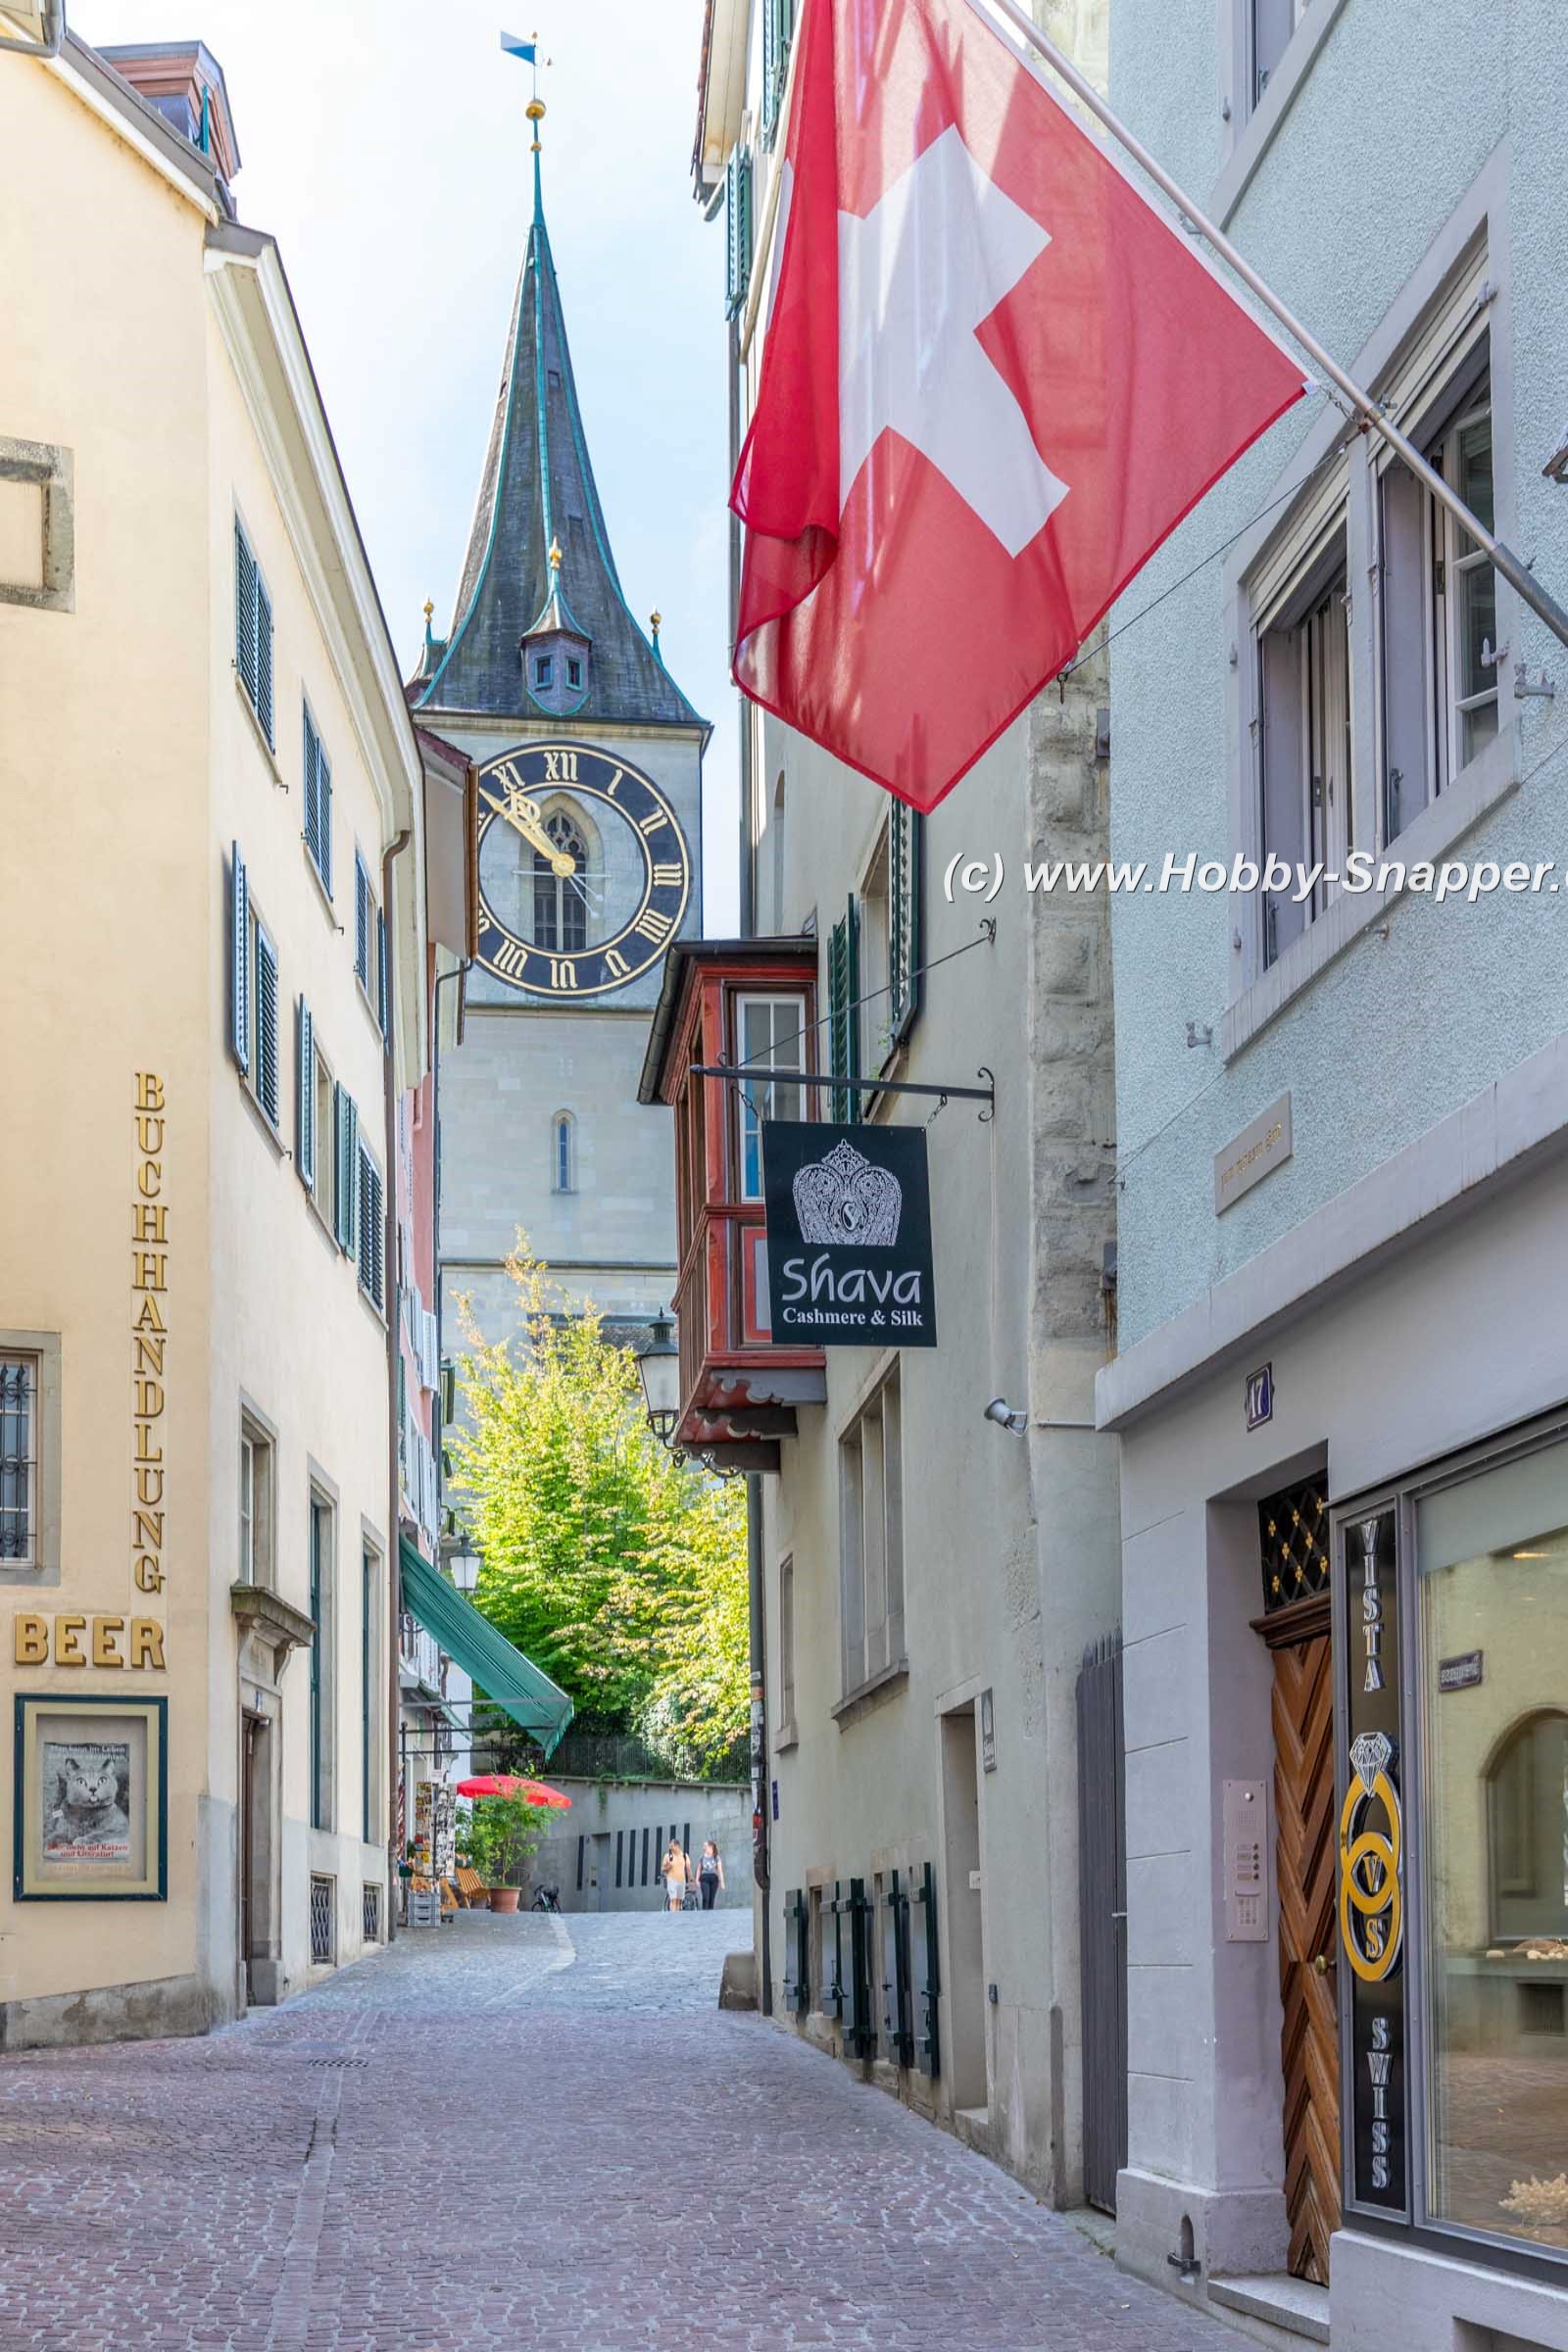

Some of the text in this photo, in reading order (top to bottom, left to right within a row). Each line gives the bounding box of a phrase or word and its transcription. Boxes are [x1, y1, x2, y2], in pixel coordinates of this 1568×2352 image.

[492, 760, 525, 794] XI
[544, 752, 578, 781] XII
[653, 861, 683, 887] III
[782, 1252, 921, 1303] Shava
[132, 1072, 169, 1593] BUCHHANDLUNG
[783, 1307, 923, 1326] Cashmere & Silk
[1360, 1520, 1386, 1692] VISTA
[15, 1613, 167, 1669] BEER
[101, 1842, 128, 1851] Katzen
[1366, 2017, 1393, 2188] SWISS
